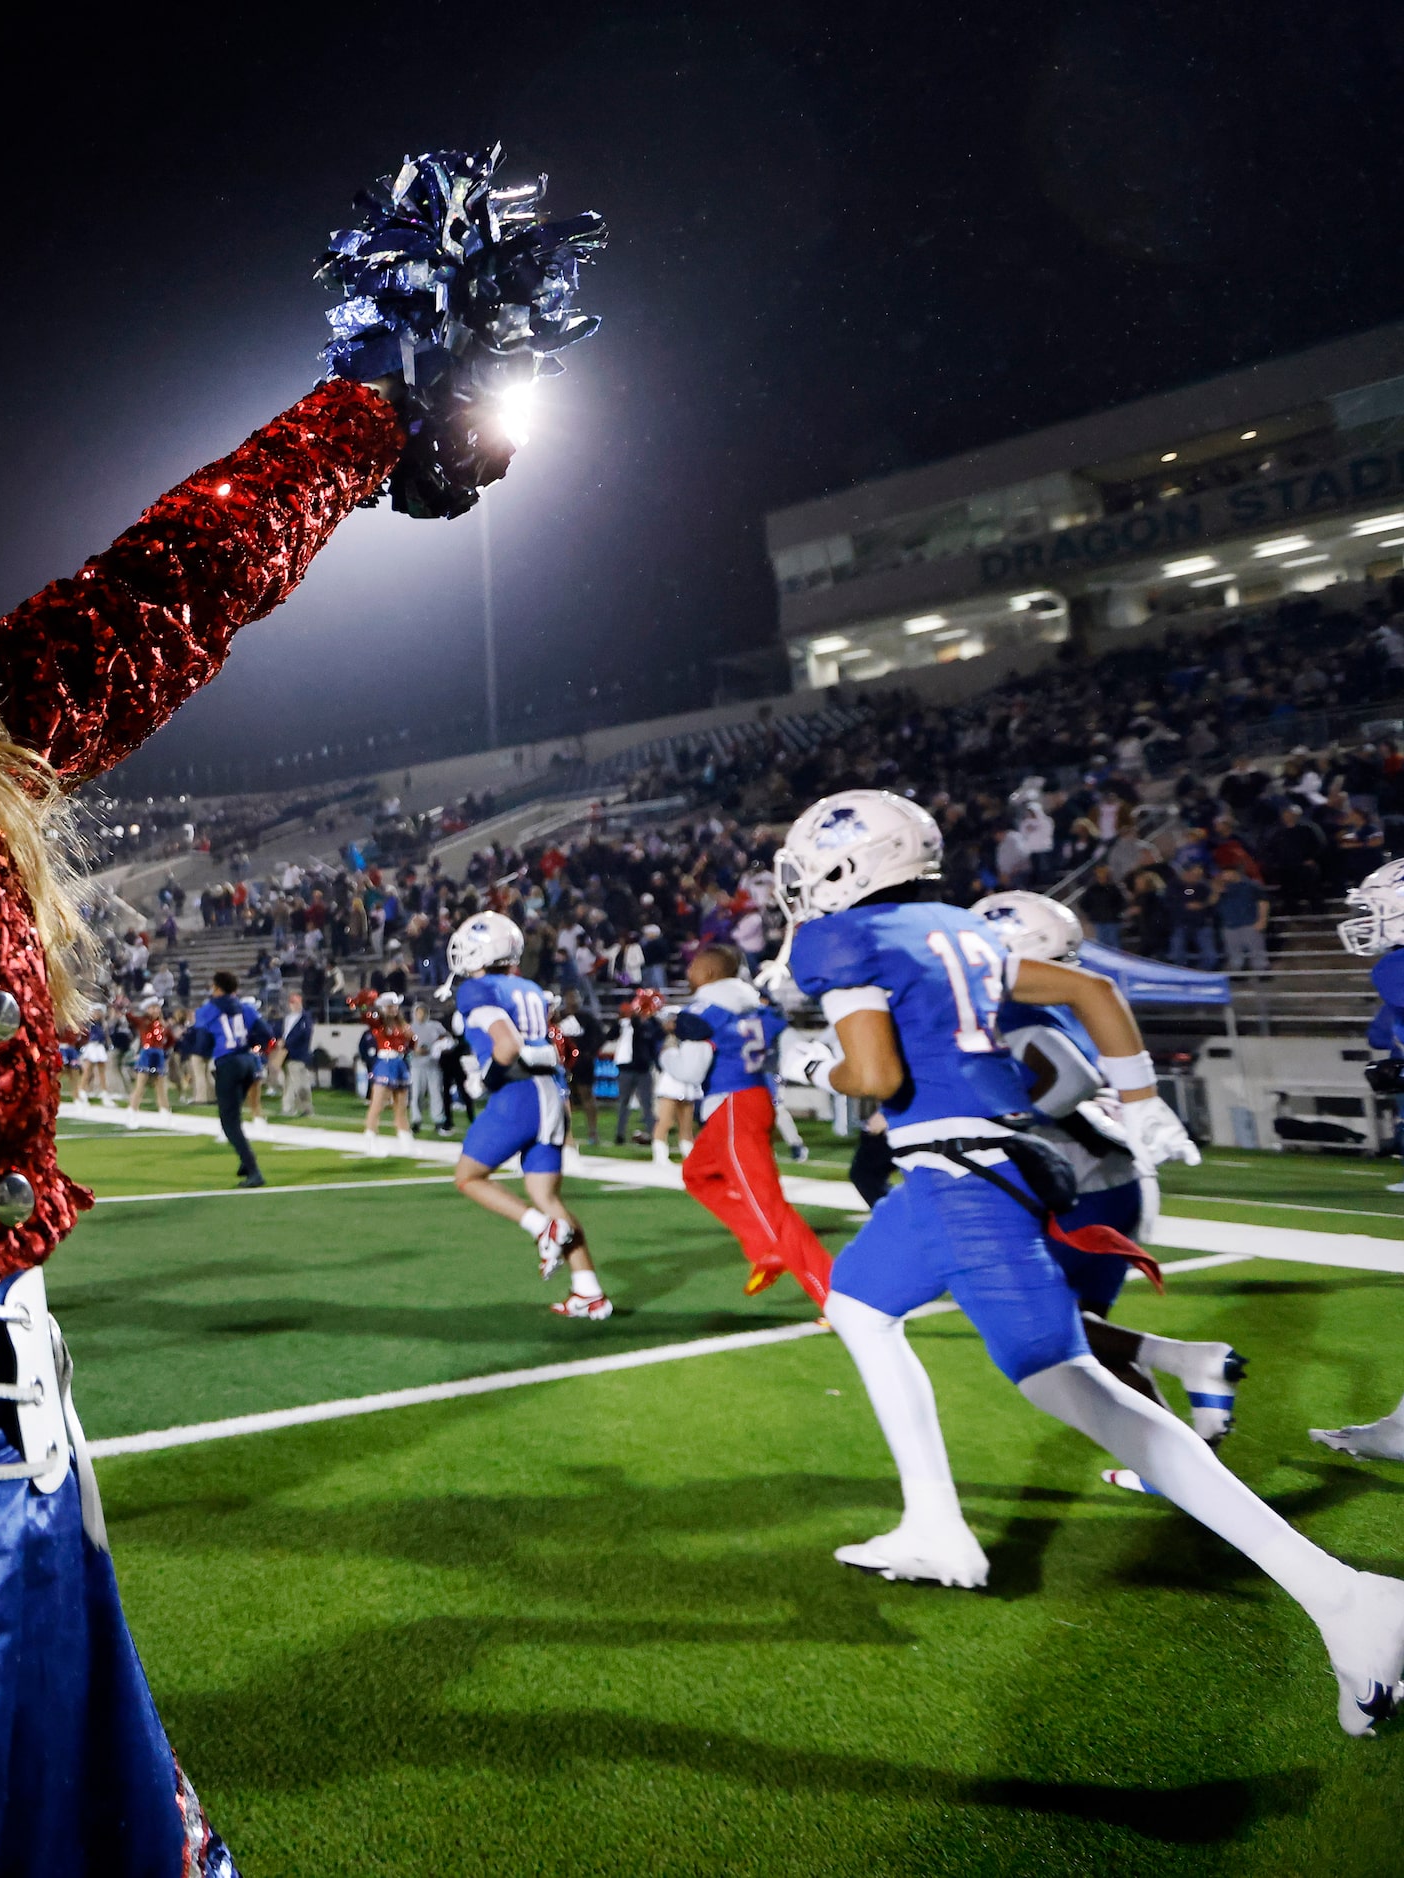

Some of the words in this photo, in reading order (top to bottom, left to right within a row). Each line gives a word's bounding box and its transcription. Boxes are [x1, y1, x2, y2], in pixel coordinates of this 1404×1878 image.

[981, 504, 1201, 583] DRAGON
[219, 1012, 248, 1050] 14
[511, 989, 547, 1041] 10
